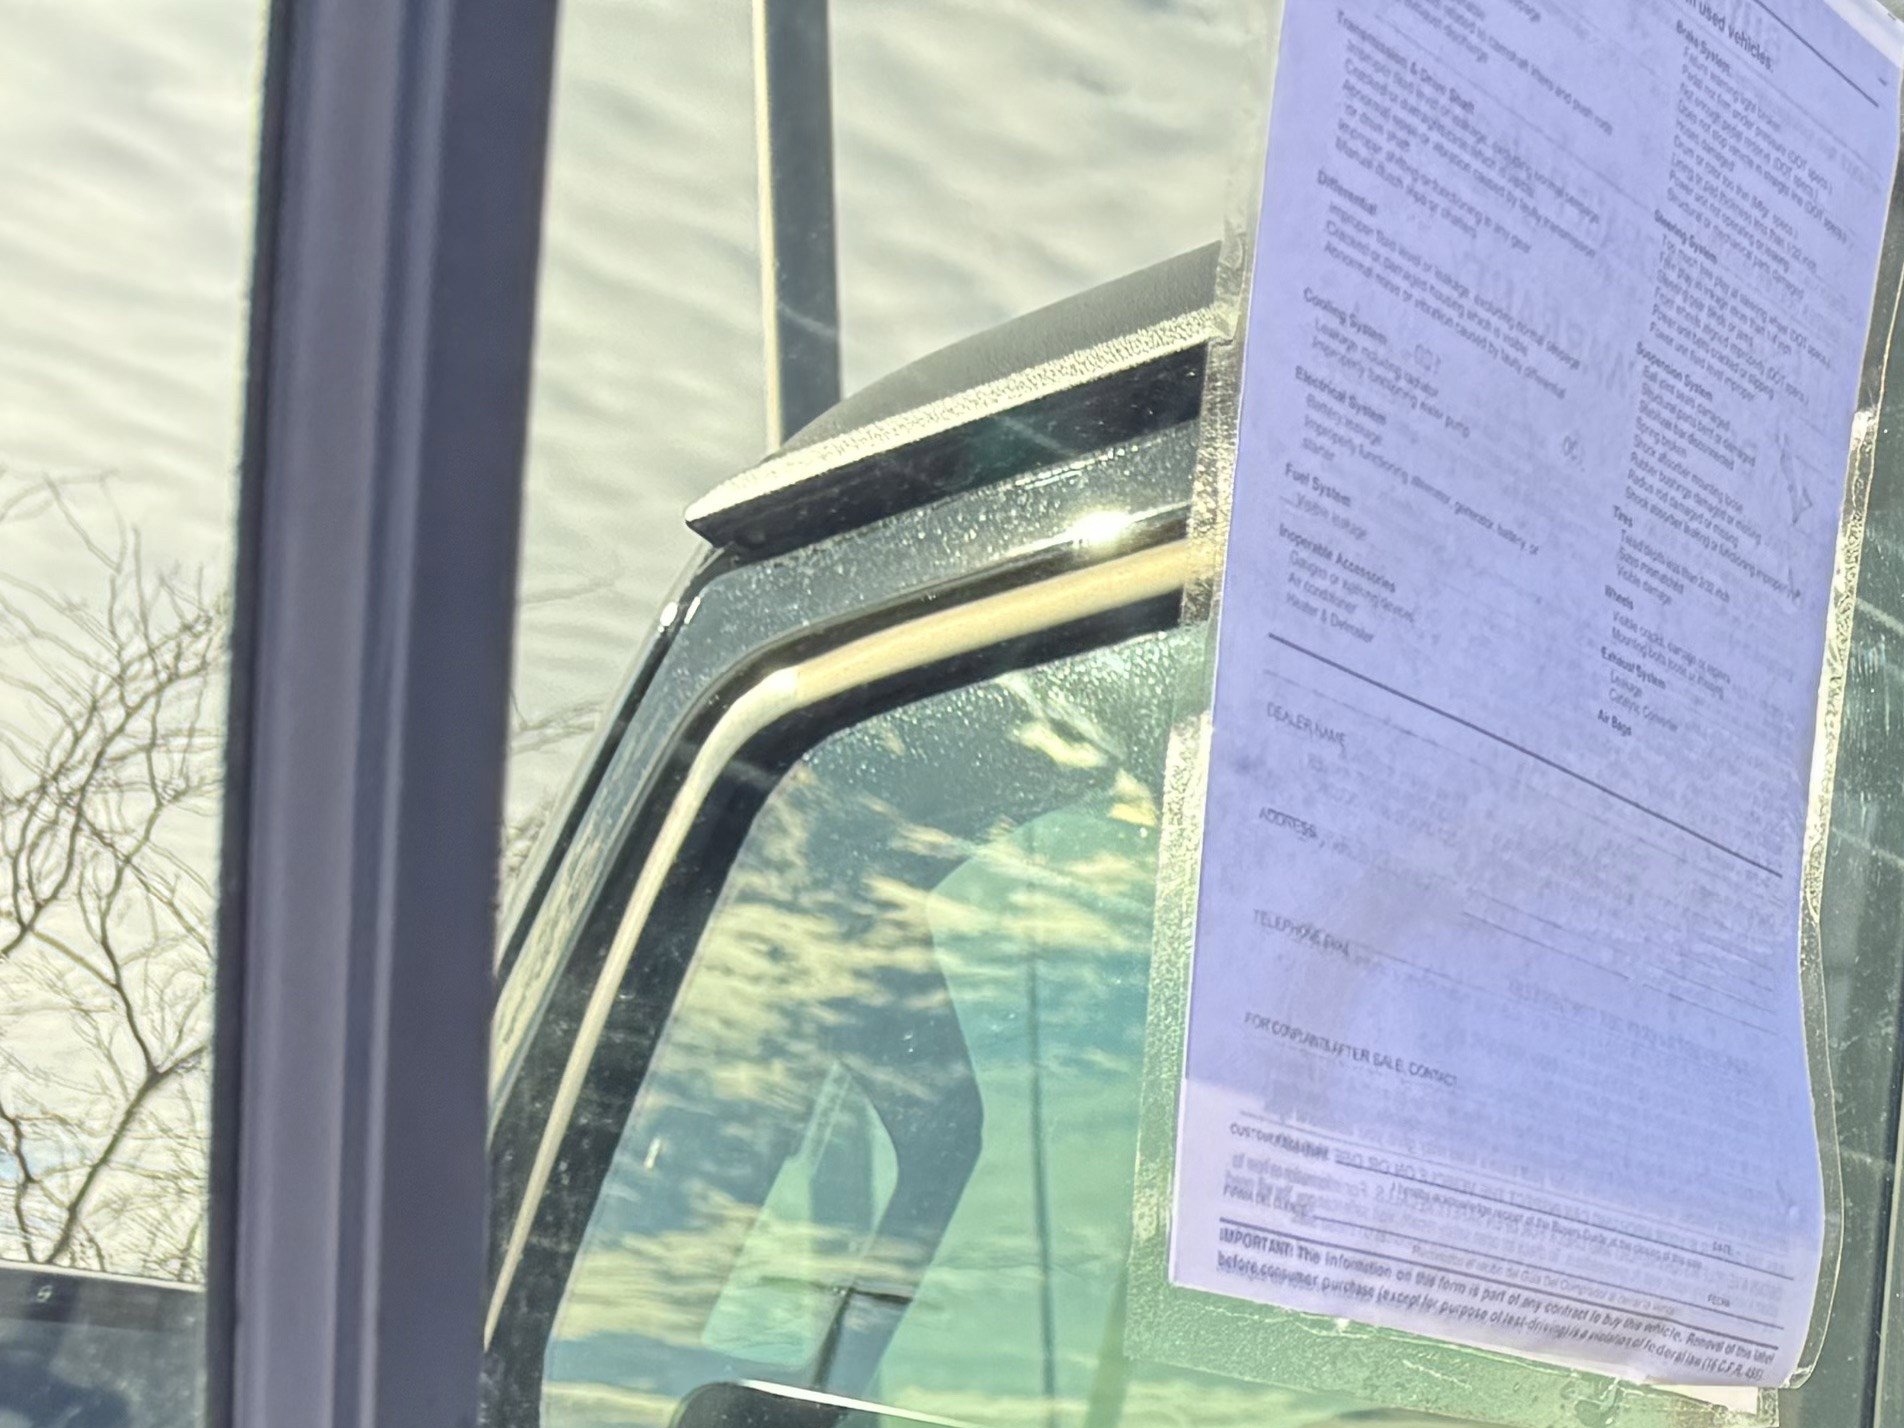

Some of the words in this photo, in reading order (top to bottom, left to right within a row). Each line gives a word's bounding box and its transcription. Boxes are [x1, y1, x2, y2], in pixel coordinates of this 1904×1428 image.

[1698, 0, 1725, 34] used
[1284, 459, 1310, 488] Fuel
[1597, 707, 1610, 728] Air
[1610, 714, 1632, 740] Bags
